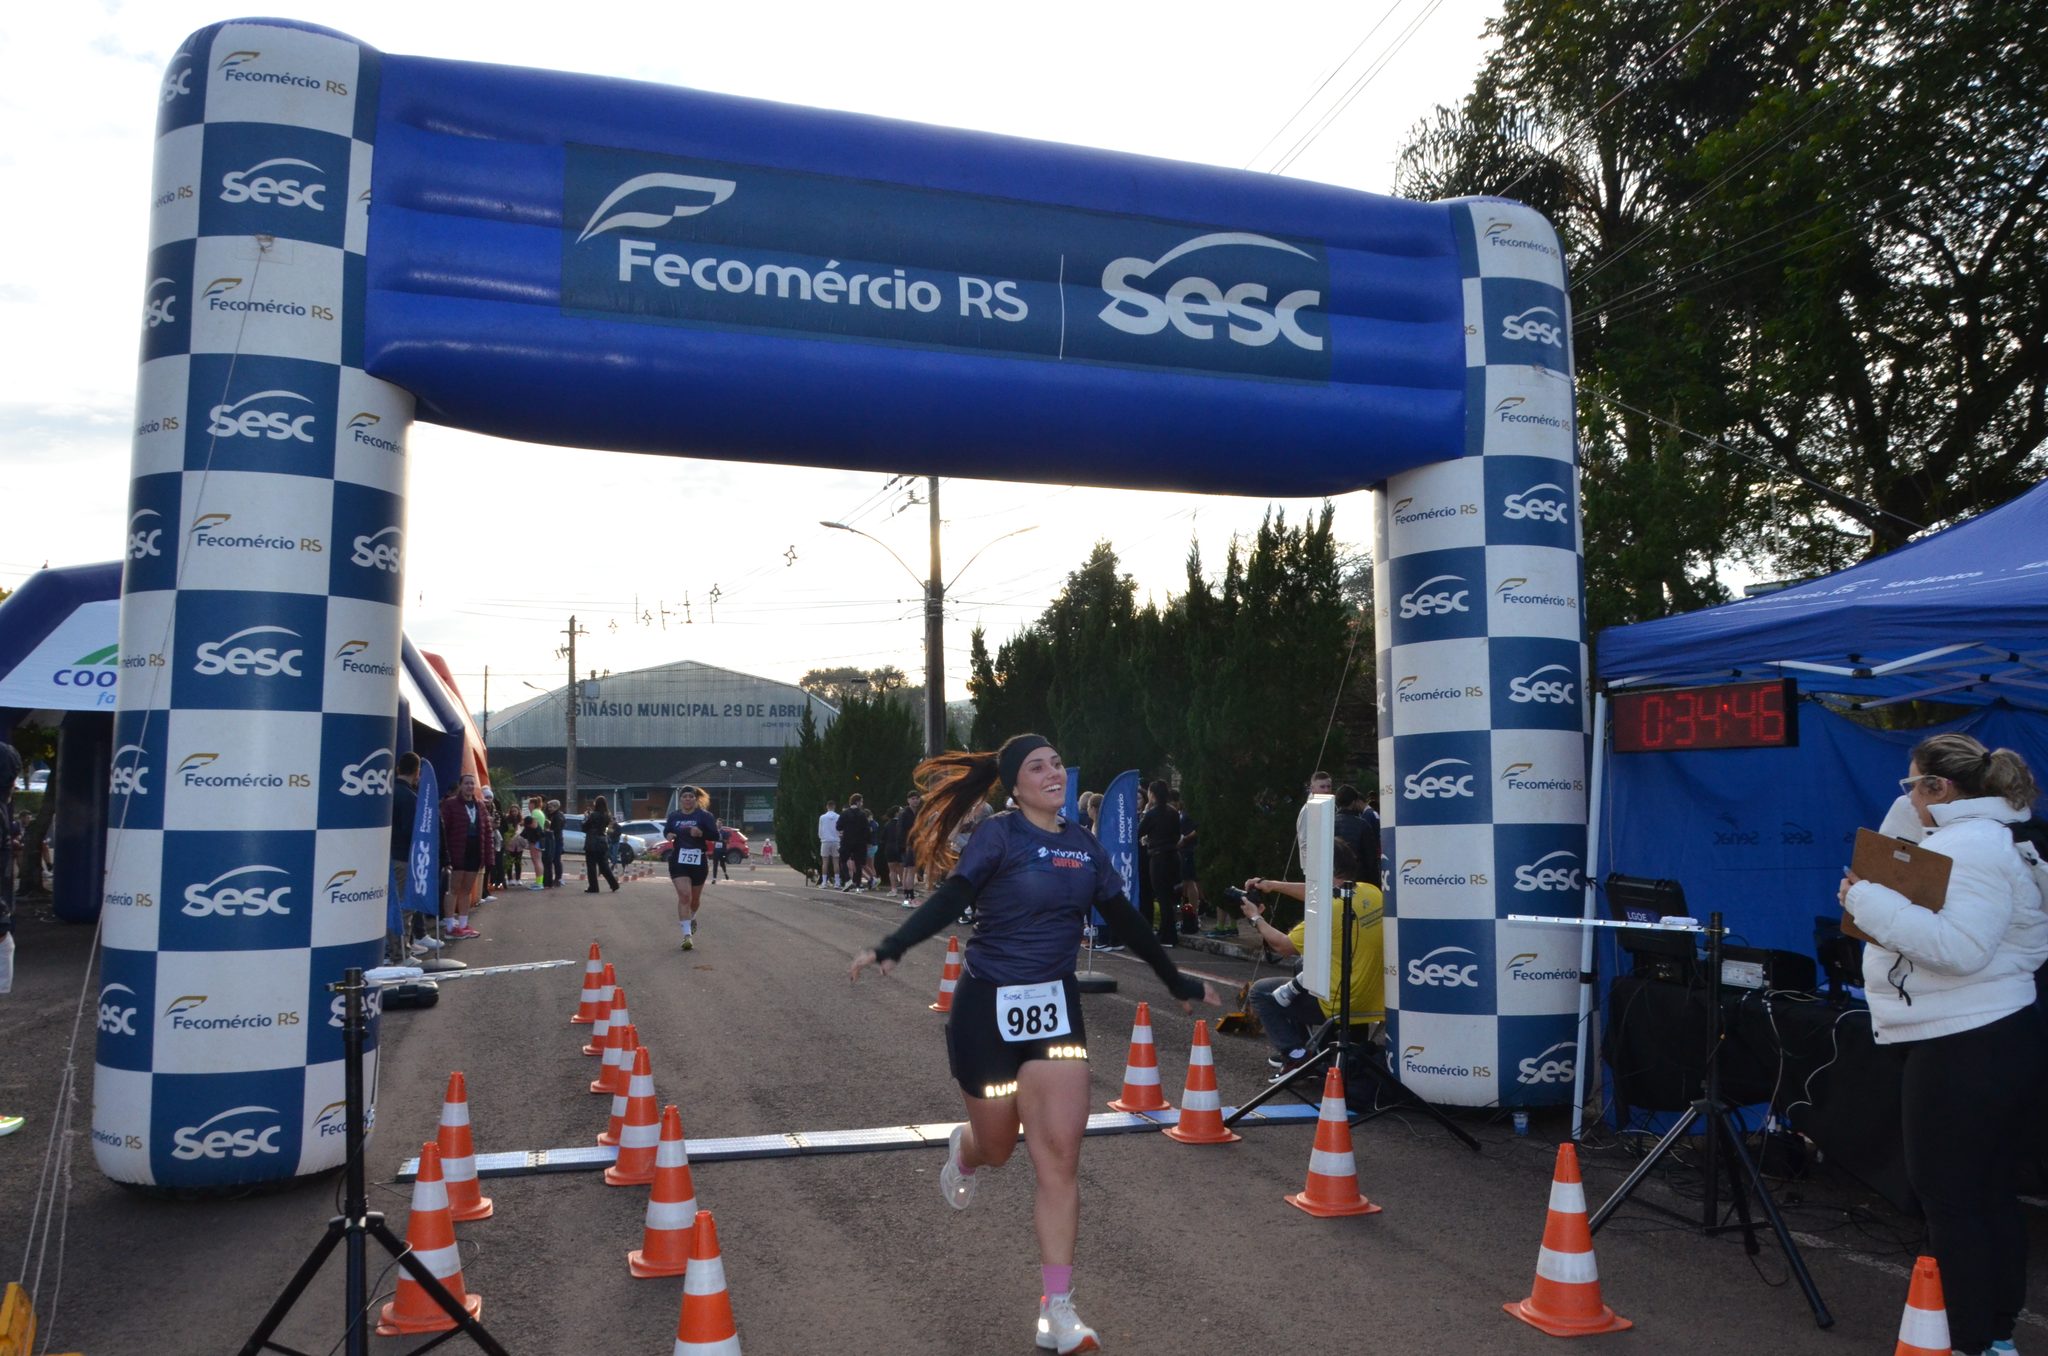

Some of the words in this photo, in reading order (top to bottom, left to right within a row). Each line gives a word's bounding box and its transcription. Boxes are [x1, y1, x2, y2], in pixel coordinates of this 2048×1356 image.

[225, 67, 320, 90] Fecomércio
[326, 79, 348, 96] RS
[178, 186, 193, 200] RS
[219, 171, 326, 211] Sesc
[1492, 236, 1549, 254] Fecomércio
[618, 239, 941, 314] Fecomércio
[959, 277, 1029, 323] RS
[1097, 256, 1324, 351] Sesc
[210, 298, 306, 317] Fecomércio
[311, 305, 334, 321] RS
[1502, 315, 1562, 348] Sesc
[162, 416, 179, 430] RS
[206, 404, 314, 443] Sesc
[1501, 412, 1560, 428] Fecomércio
[1561, 419, 1571, 432] RS
[1395, 507, 1456, 526] Fecomércio
[1460, 504, 1478, 515] RS
[1502, 494, 1568, 524] Sesc
[197, 533, 295, 550] Fecomércio
[300, 538, 323, 552] RS
[351, 535, 404, 573] Ses
[1399, 590, 1470, 619] Sesc
[1503, 593, 1565, 607] Fecomércio
[1567, 597, 1576, 608] RS
[149, 654, 166, 667] RS
[193, 641, 303, 677] Sesc
[1400, 688, 1461, 702] Fecomércio
[1465, 686, 1483, 697] RS
[1508, 677, 1574, 704] Sesc
[637, 703, 719, 717] MUNICIPAL
[724, 704, 742, 717] 29
[746, 704, 764, 717] DE
[109, 767, 148, 795] esc
[184, 773, 283, 788] Fecomércio
[289, 773, 311, 788] RS
[1403, 774, 1474, 800] Sesc
[1508, 779, 1571, 790] Fecomércio
[1573, 780, 1583, 791] RS
[682, 853, 698, 863] 757
[1404, 874, 1465, 885] Fecomércio
[1470, 874, 1488, 885] RS
[1513, 864, 1581, 892] Sesc
[135, 893, 152, 907] RS
[181, 883, 291, 917] Sesc
[1407, 959, 1478, 987] Sesc
[1513, 968, 1577, 981] Fecomércio
[97, 1003, 136, 1036] esc
[173, 1014, 272, 1030] Fecomércio
[277, 1012, 300, 1026] RS
[1007, 1003, 1058, 1036] 983
[1406, 1061, 1469, 1077] Fecomércio
[1472, 1066, 1491, 1077] RS
[1516, 1057, 1575, 1084] Ses
[985, 1081, 1018, 1098] RUN
[125, 1135, 142, 1150] RS
[171, 1124, 281, 1161] Sesc
